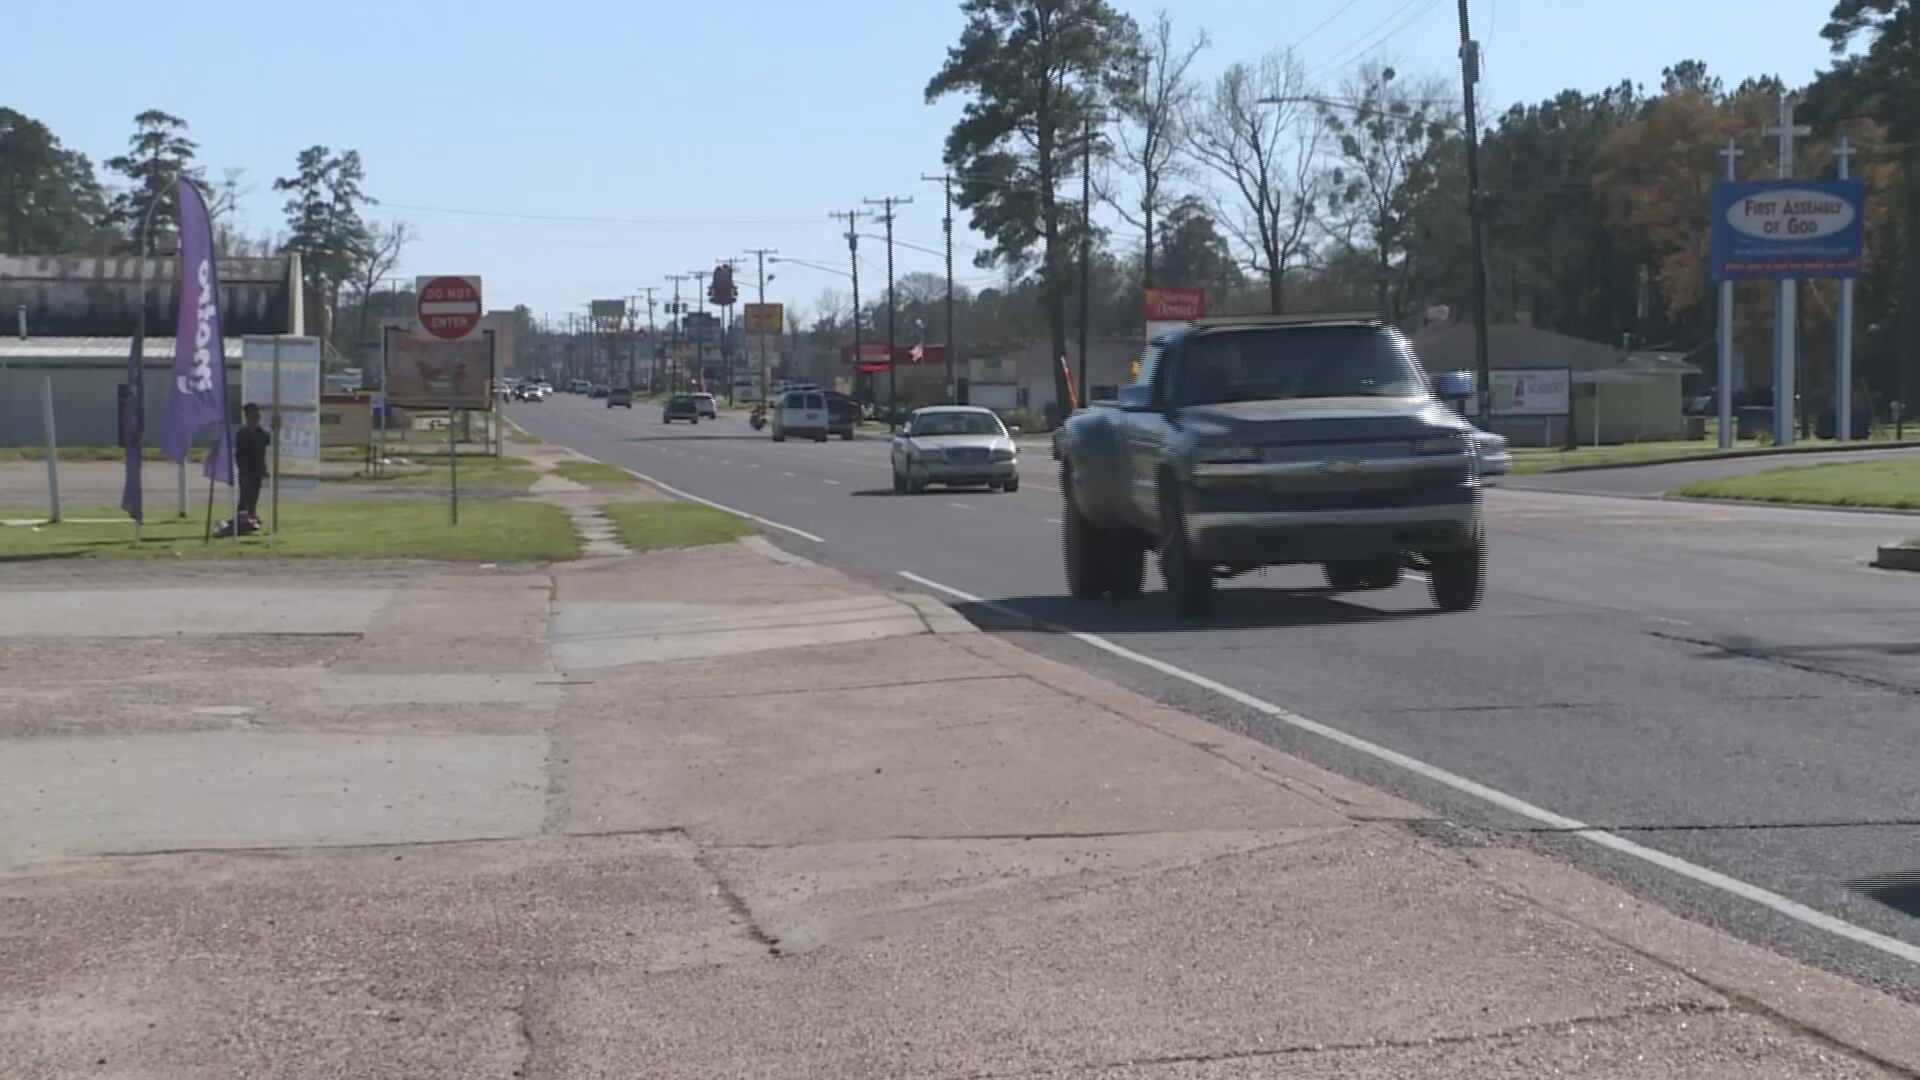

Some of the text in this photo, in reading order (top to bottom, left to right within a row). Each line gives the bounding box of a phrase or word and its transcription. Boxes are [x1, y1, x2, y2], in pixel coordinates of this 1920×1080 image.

[1744, 199, 1844, 216] FIRST ASSEMBLY
[1763, 217, 1819, 235] OF GOD
[426, 287, 472, 299] DO NOT
[431, 316, 468, 329] ENTER
